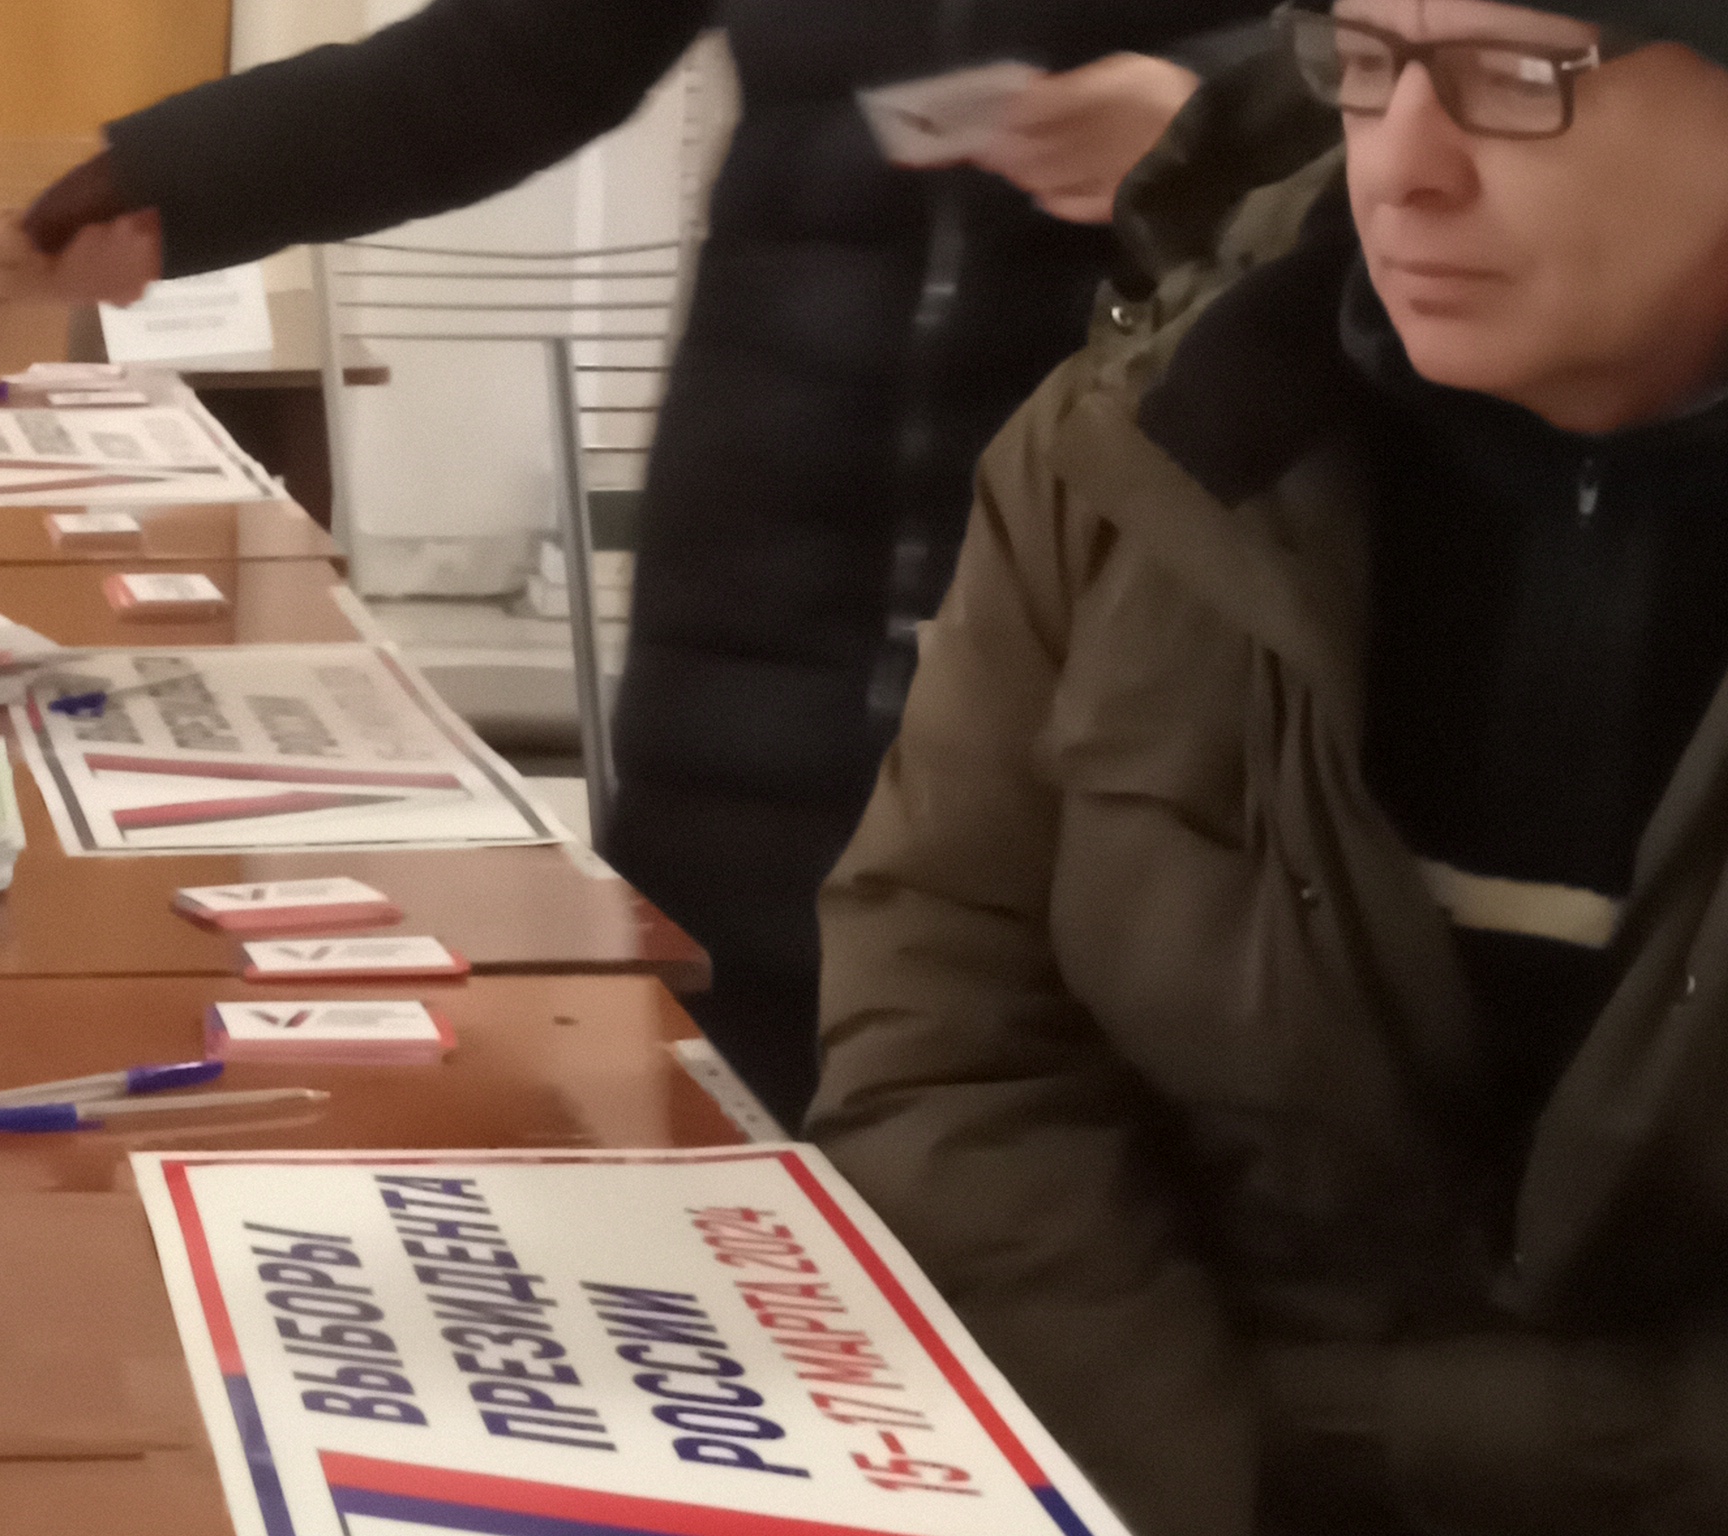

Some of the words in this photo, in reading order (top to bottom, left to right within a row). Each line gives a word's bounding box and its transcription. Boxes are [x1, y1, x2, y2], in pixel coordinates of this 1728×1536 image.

[243, 1220, 429, 1427] ВЫБОРЫ
[374, 1174, 617, 1452] ПРЕЗИДЕНТА
[684, 1206, 820, 1275] 2024
[734, 1279, 905, 1390] МАРТА
[579, 1280, 812, 1479] РОССИИ
